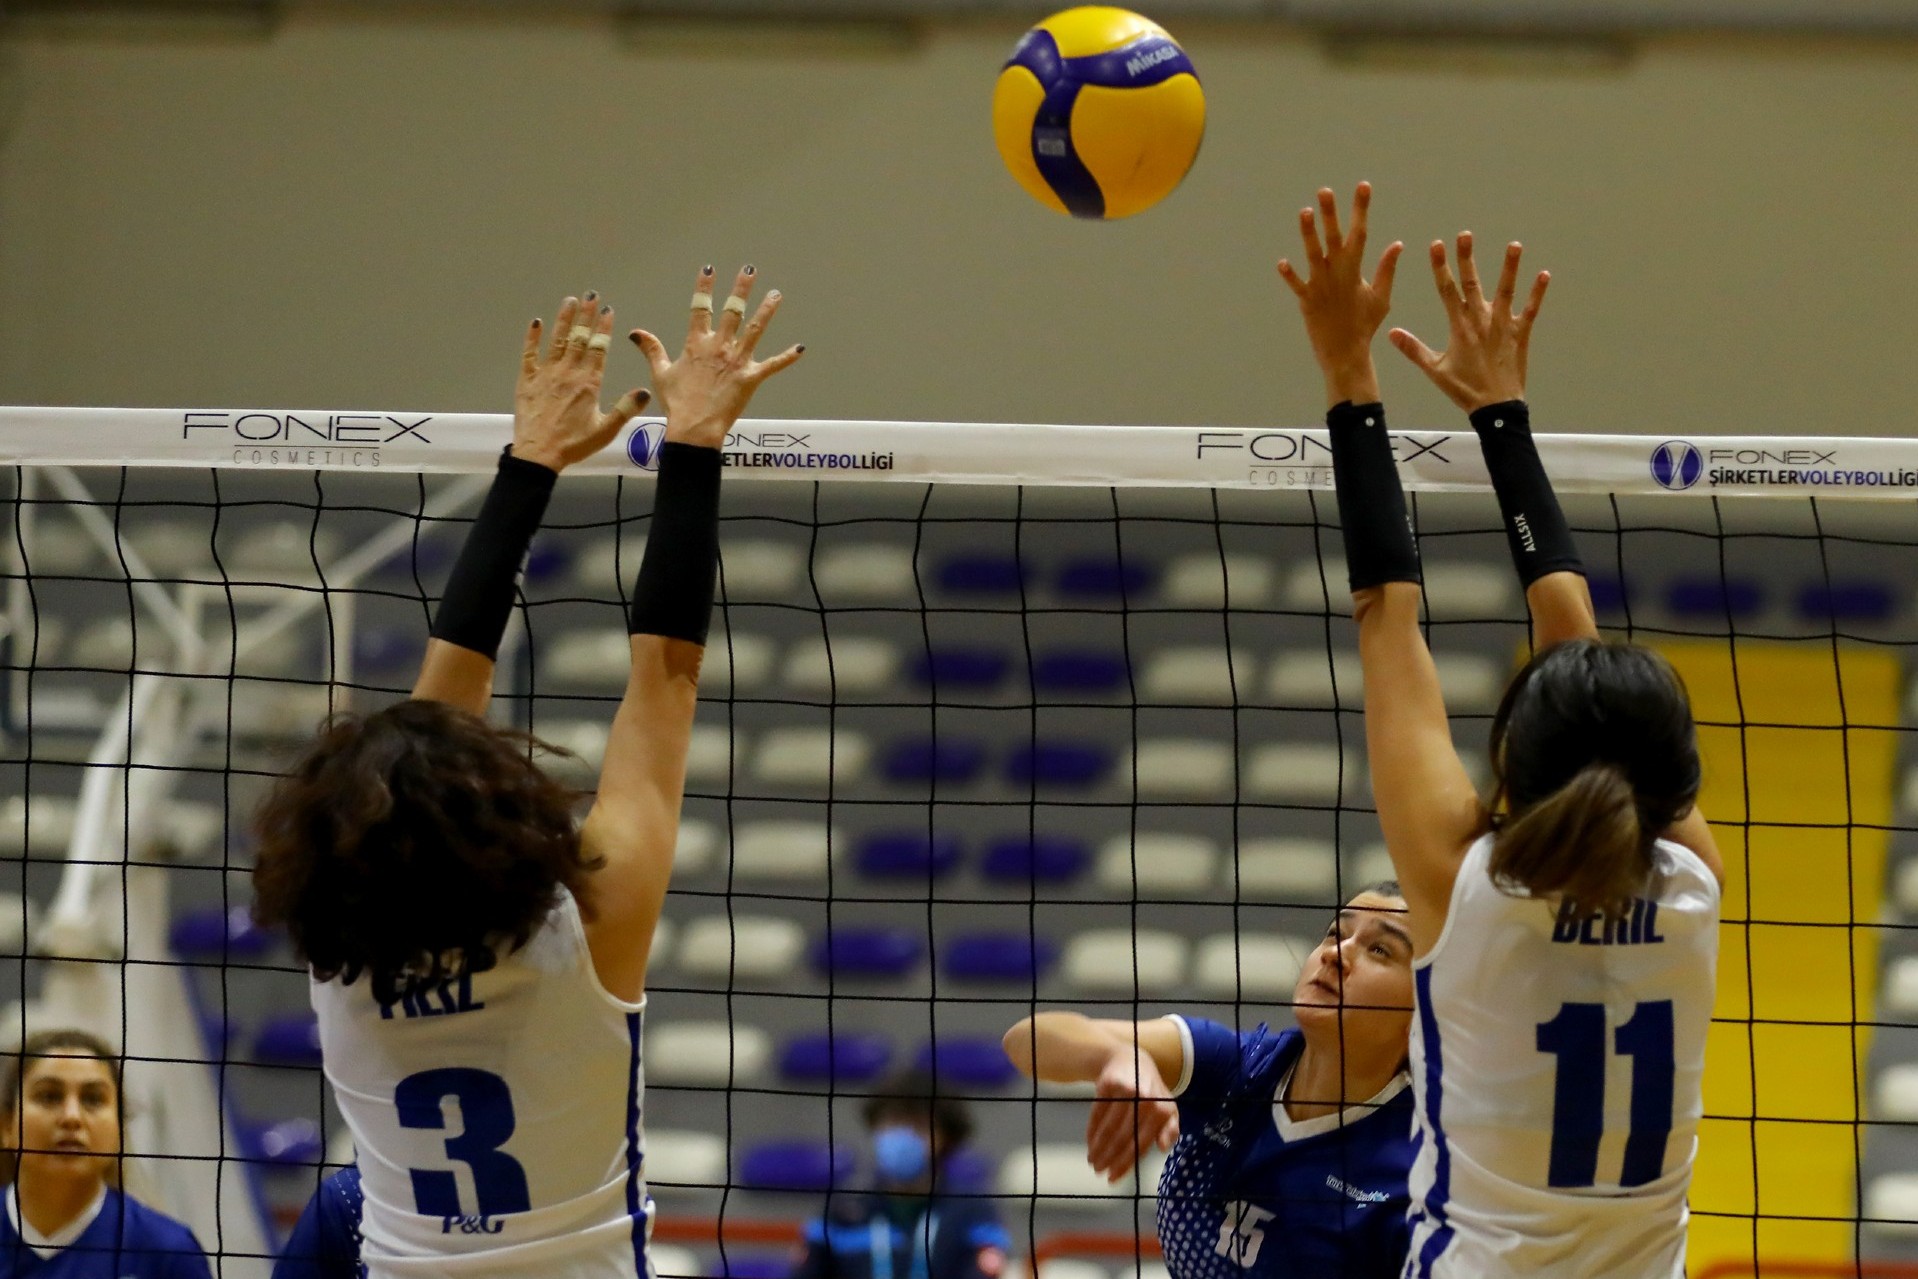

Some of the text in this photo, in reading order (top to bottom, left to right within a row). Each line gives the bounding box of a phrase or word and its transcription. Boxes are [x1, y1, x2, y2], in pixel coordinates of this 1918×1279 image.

[184, 413, 433, 443] FONEX
[722, 433, 811, 448] ONEX
[233, 450, 380, 467] COSMETICS
[721, 451, 893, 470] ETLERVOLEYBOLLİGİ
[1197, 433, 1451, 463] FONX
[1710, 450, 1837, 465] FONEX
[1250, 470, 1333, 486] COSME
[1513, 513, 1536, 552] ALLSIX
[1536, 999, 1675, 1188] 11
[394, 1067, 532, 1218] 3
[442, 1214, 505, 1234] P&G
[1214, 1200, 1277, 1269] 15
